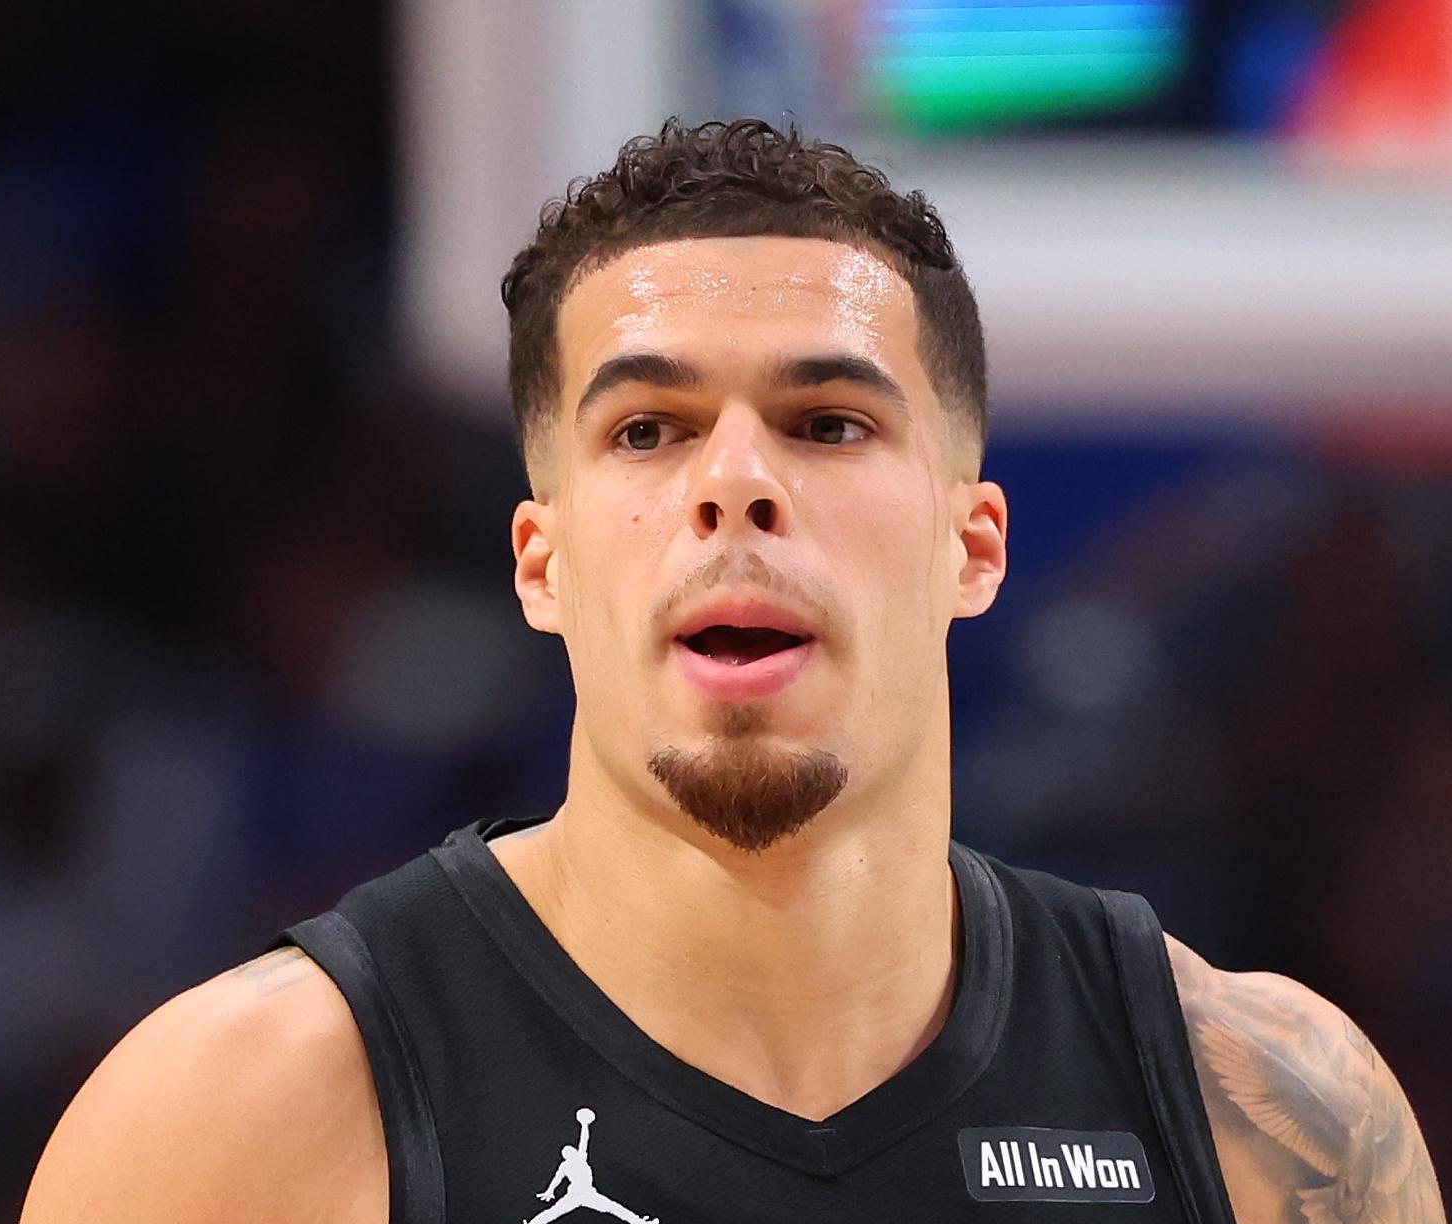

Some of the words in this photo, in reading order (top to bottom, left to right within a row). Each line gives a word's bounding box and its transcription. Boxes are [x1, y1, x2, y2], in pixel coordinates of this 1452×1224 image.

[981, 1141, 1025, 1187] All
[1028, 1142, 1064, 1188] In
[1061, 1144, 1141, 1189] Won
